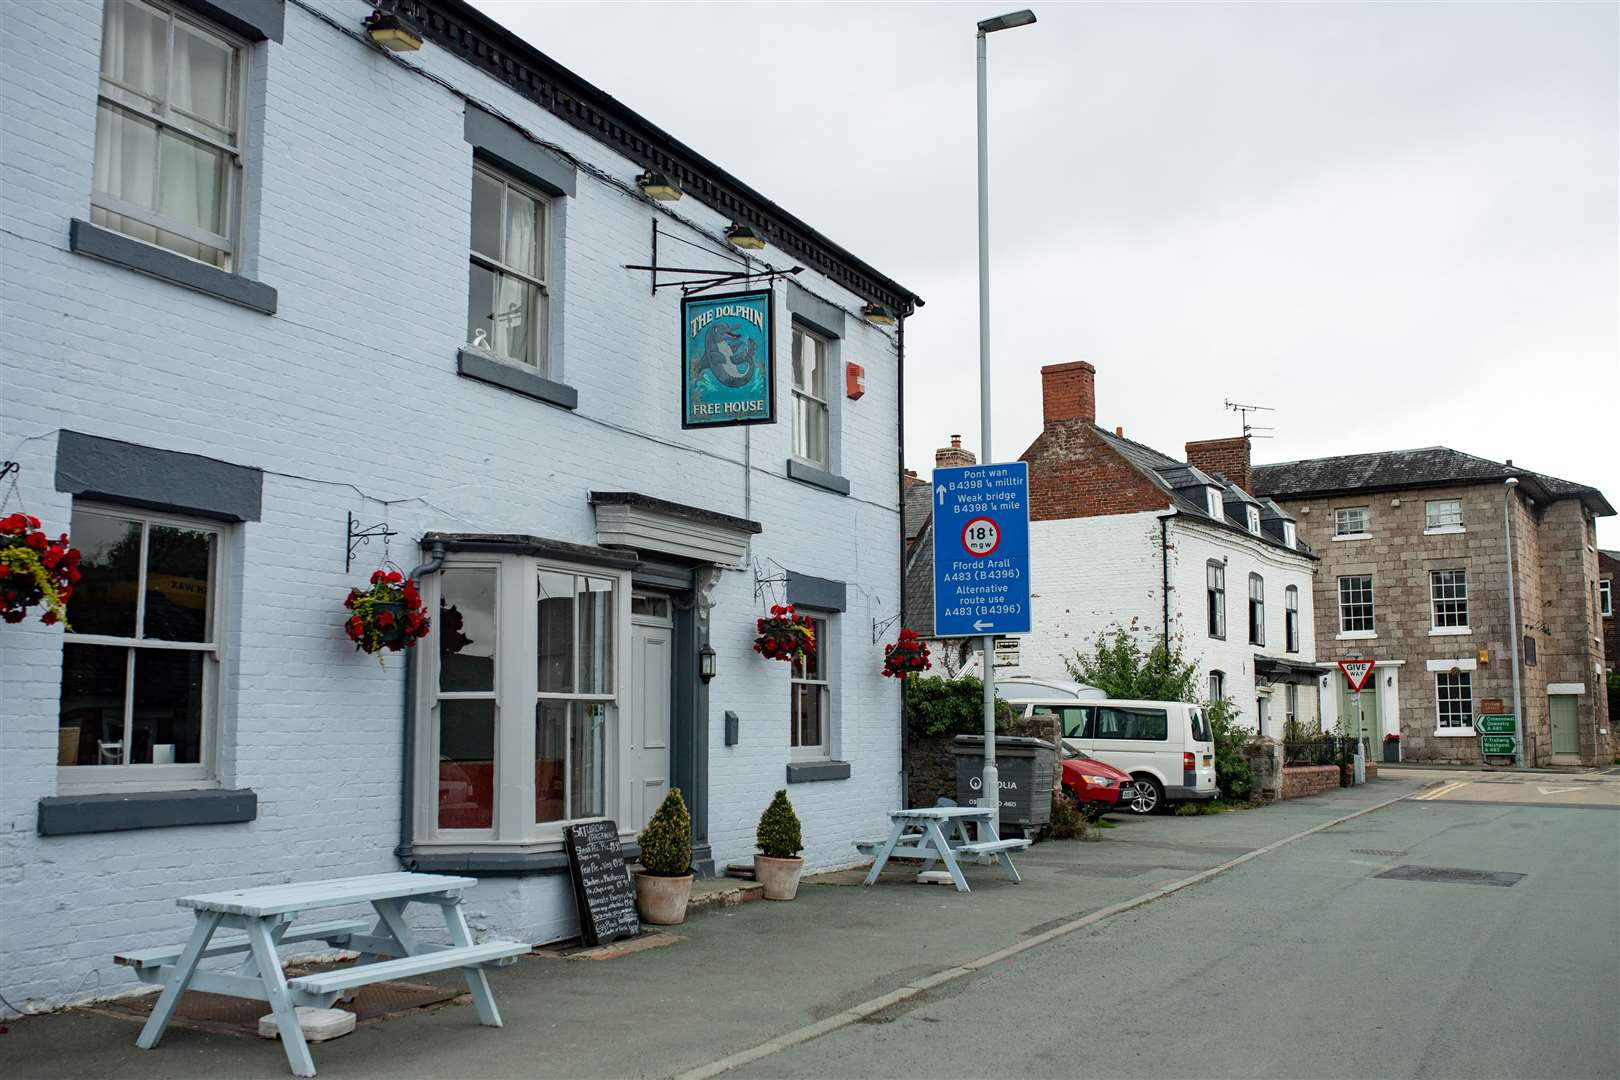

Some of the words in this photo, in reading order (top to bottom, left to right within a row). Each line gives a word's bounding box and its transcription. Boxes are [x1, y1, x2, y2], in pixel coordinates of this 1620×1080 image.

[690, 311, 712, 337] THE
[716, 304, 764, 332] DOLPHIN
[693, 402, 720, 416] FREE
[724, 400, 764, 412] HOUSE
[964, 470, 986, 479] Pont
[988, 468, 1008, 478] wan
[996, 477, 1024, 486] milltir
[958, 494, 982, 503] Weak
[986, 491, 1016, 502] bridge
[1000, 501, 1020, 510] mile
[953, 560, 984, 570] Ffordd
[988, 558, 1010, 568] Arall
[956, 583, 1008, 594] Alternative
[960, 595, 985, 604] route
[988, 594, 1006, 604] use
